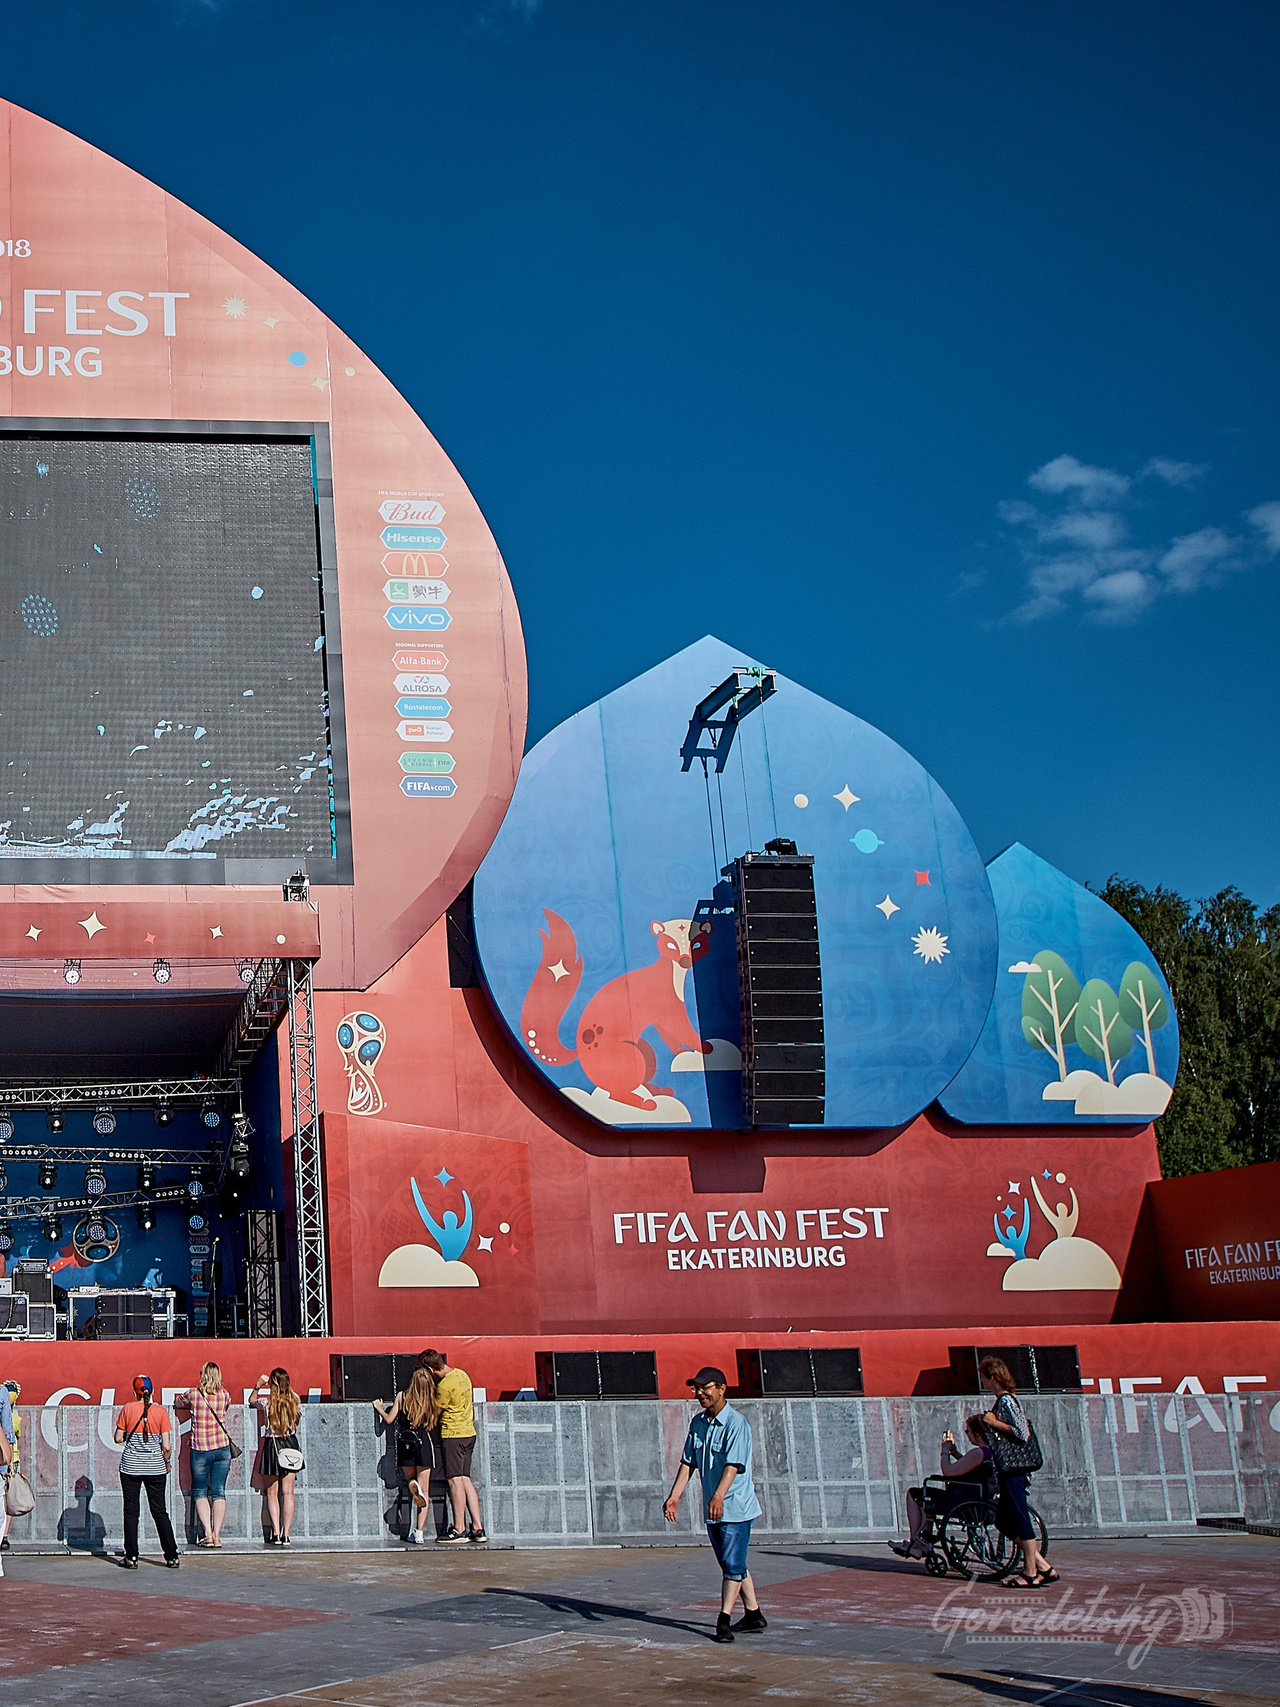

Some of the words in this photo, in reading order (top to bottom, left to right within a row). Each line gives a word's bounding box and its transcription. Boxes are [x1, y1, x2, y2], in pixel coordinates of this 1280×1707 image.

[23, 289, 190, 337] FEST
[384, 502, 438, 521] Bud
[386, 533, 441, 544] Hisense
[391, 609, 445, 625] vivo
[399, 656, 442, 666] Alfa-Bank
[402, 684, 443, 693] ALROSA
[404, 703, 444, 711] Rostelecom
[613, 1212, 699, 1244] FIFA
[707, 1211, 786, 1241] FAN
[796, 1208, 890, 1240] FEST
[666, 1246, 846, 1269] EKATERINBURG
[1184, 1246, 1222, 1269] FIFA
[1224, 1242, 1260, 1266] FAN
